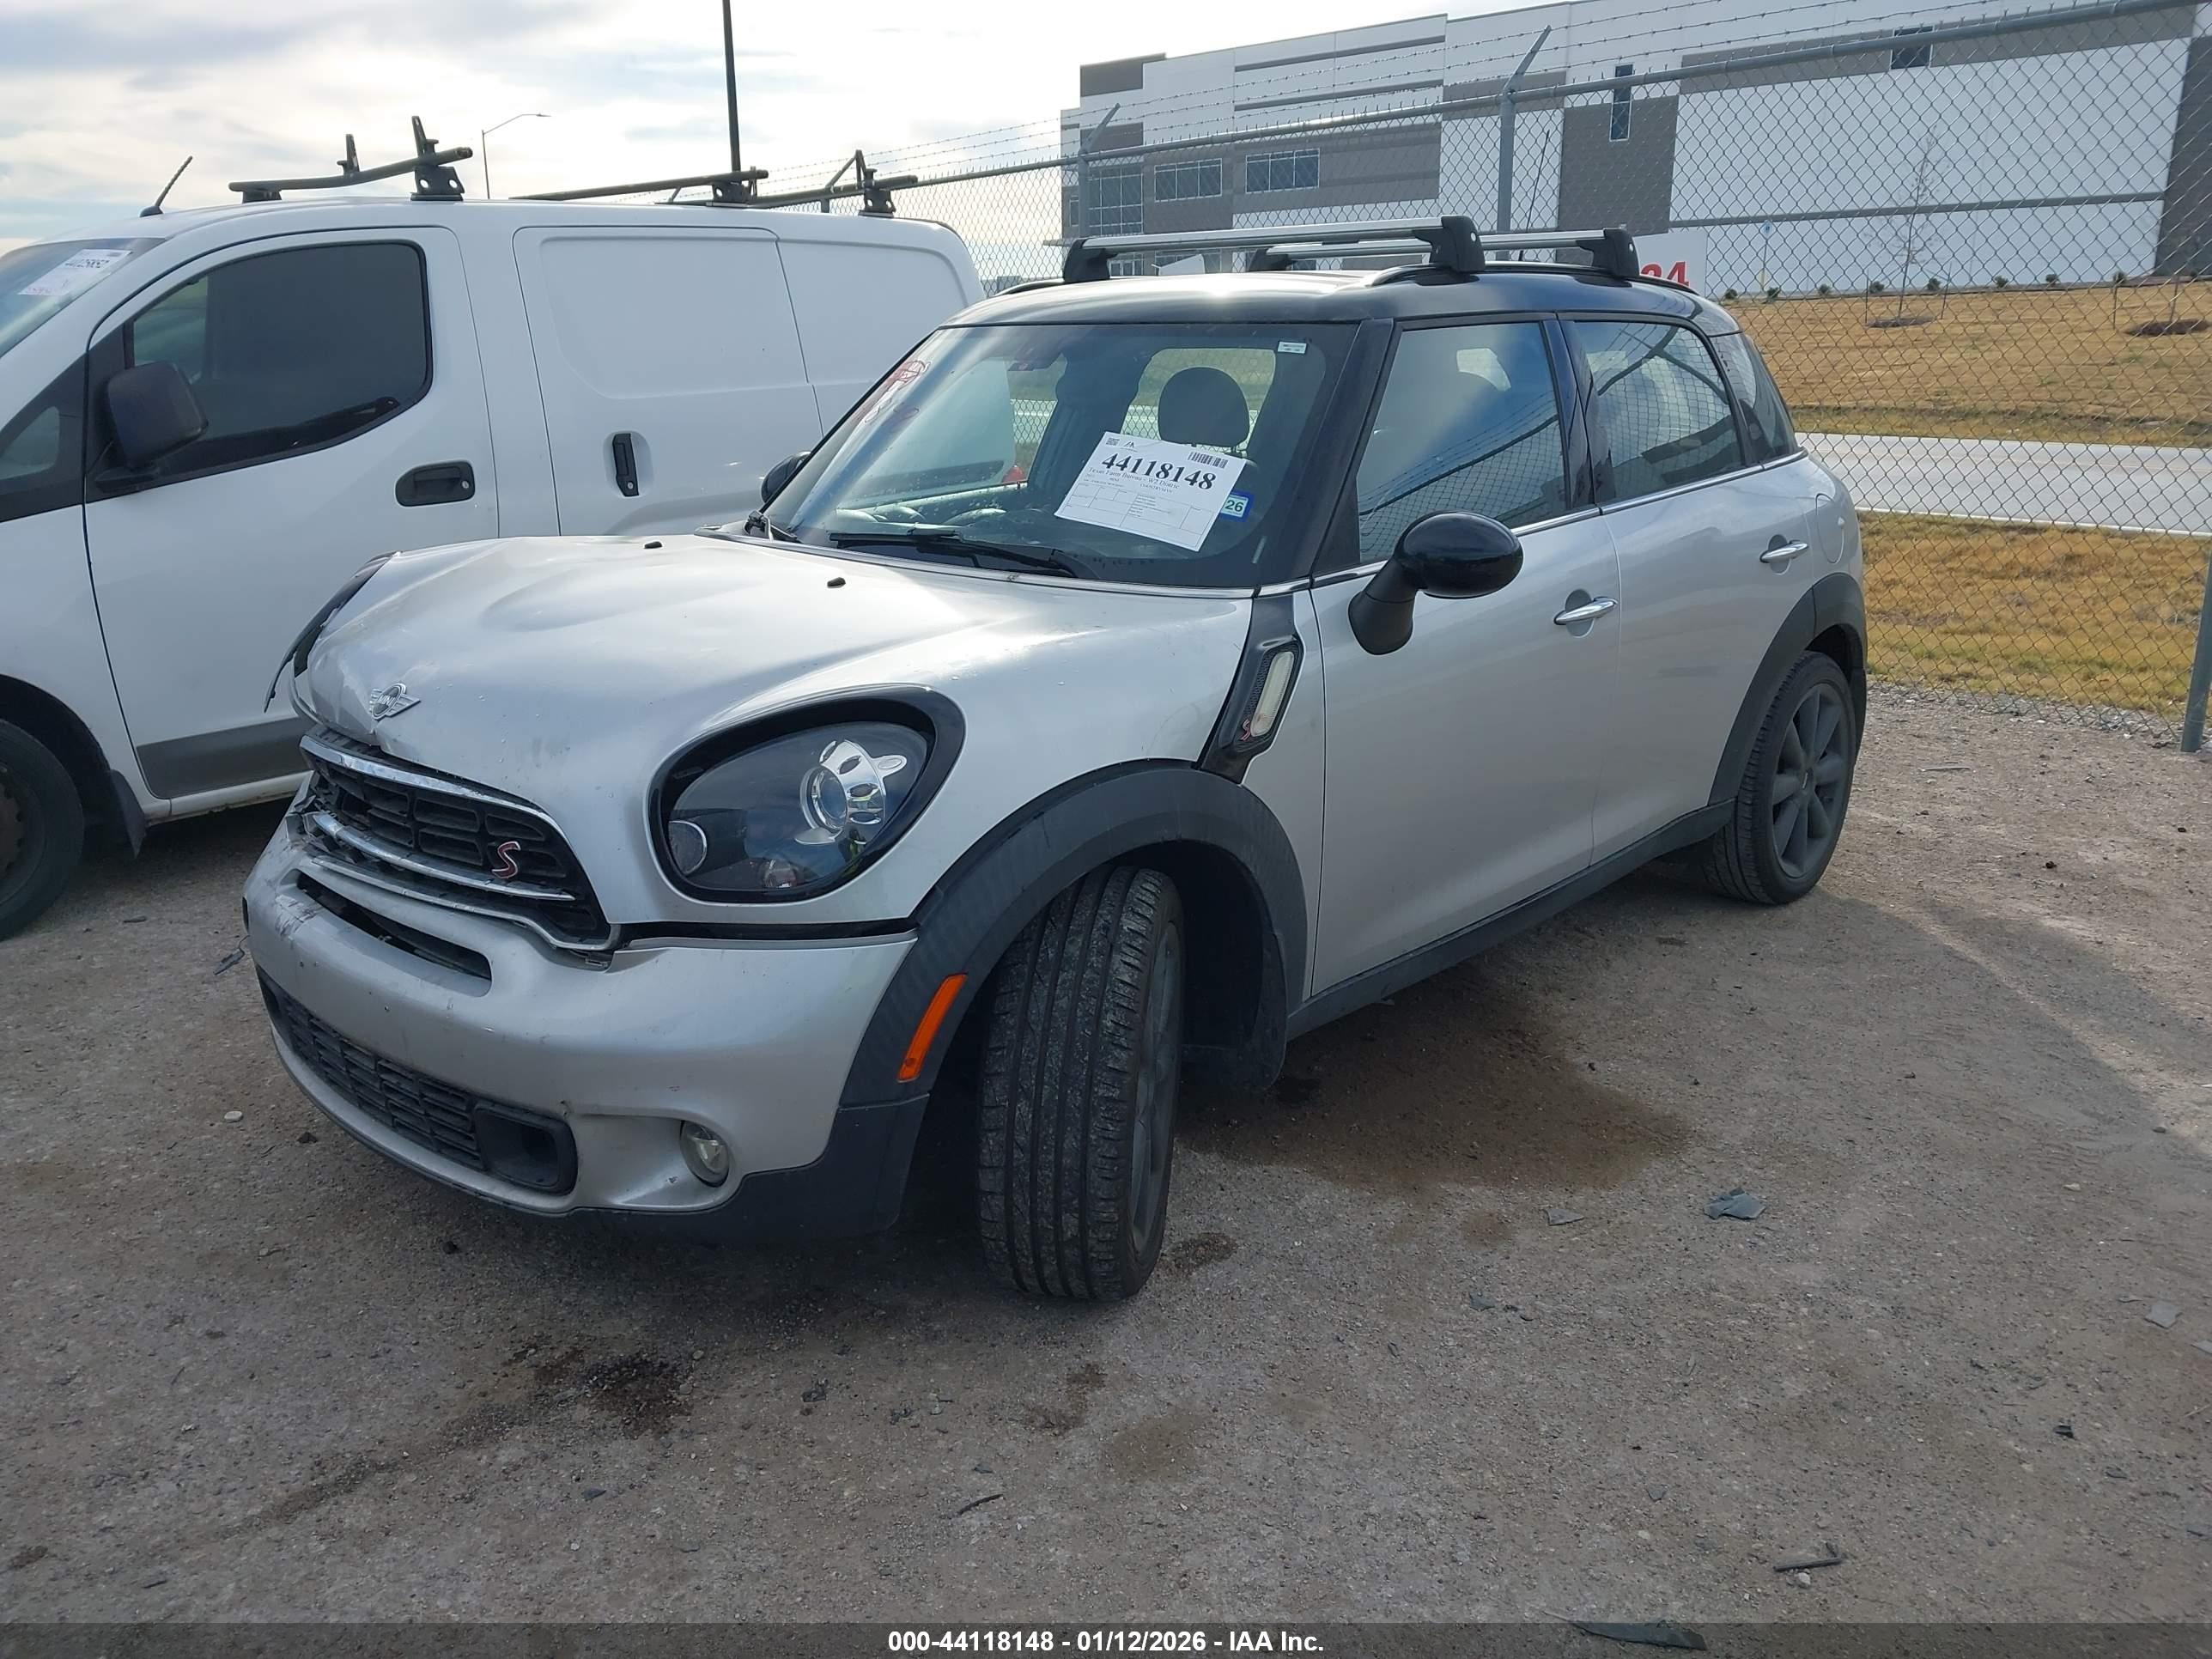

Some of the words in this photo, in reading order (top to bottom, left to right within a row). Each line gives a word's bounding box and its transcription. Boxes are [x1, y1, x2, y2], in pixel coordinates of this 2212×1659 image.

[1102, 453, 1216, 490] 44118148
[1224, 500, 1244, 513] 26
[491, 841, 521, 879] S
